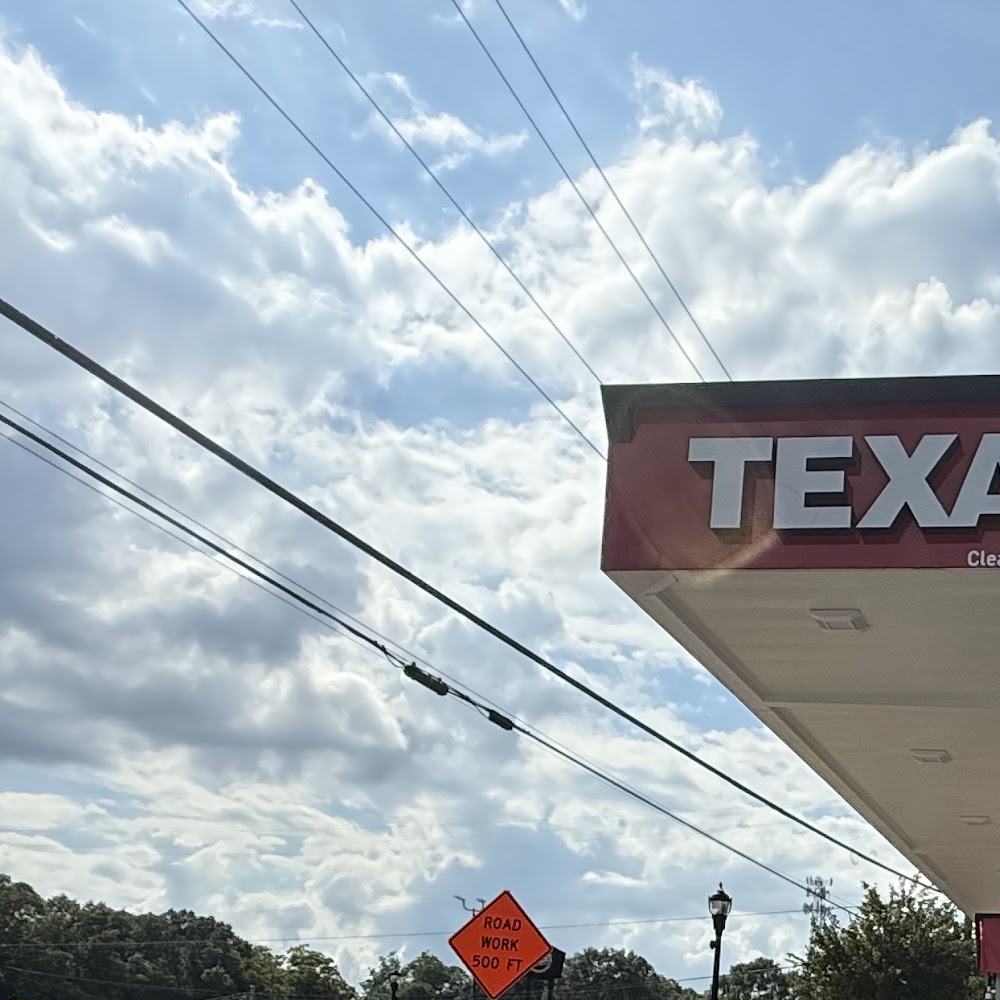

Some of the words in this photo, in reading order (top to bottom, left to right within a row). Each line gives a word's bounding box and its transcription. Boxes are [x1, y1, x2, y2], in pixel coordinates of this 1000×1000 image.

[484, 917, 522, 931] ROAD
[481, 936, 519, 951] WORK
[472, 955, 500, 970] 500
[507, 958, 523, 972] FT
